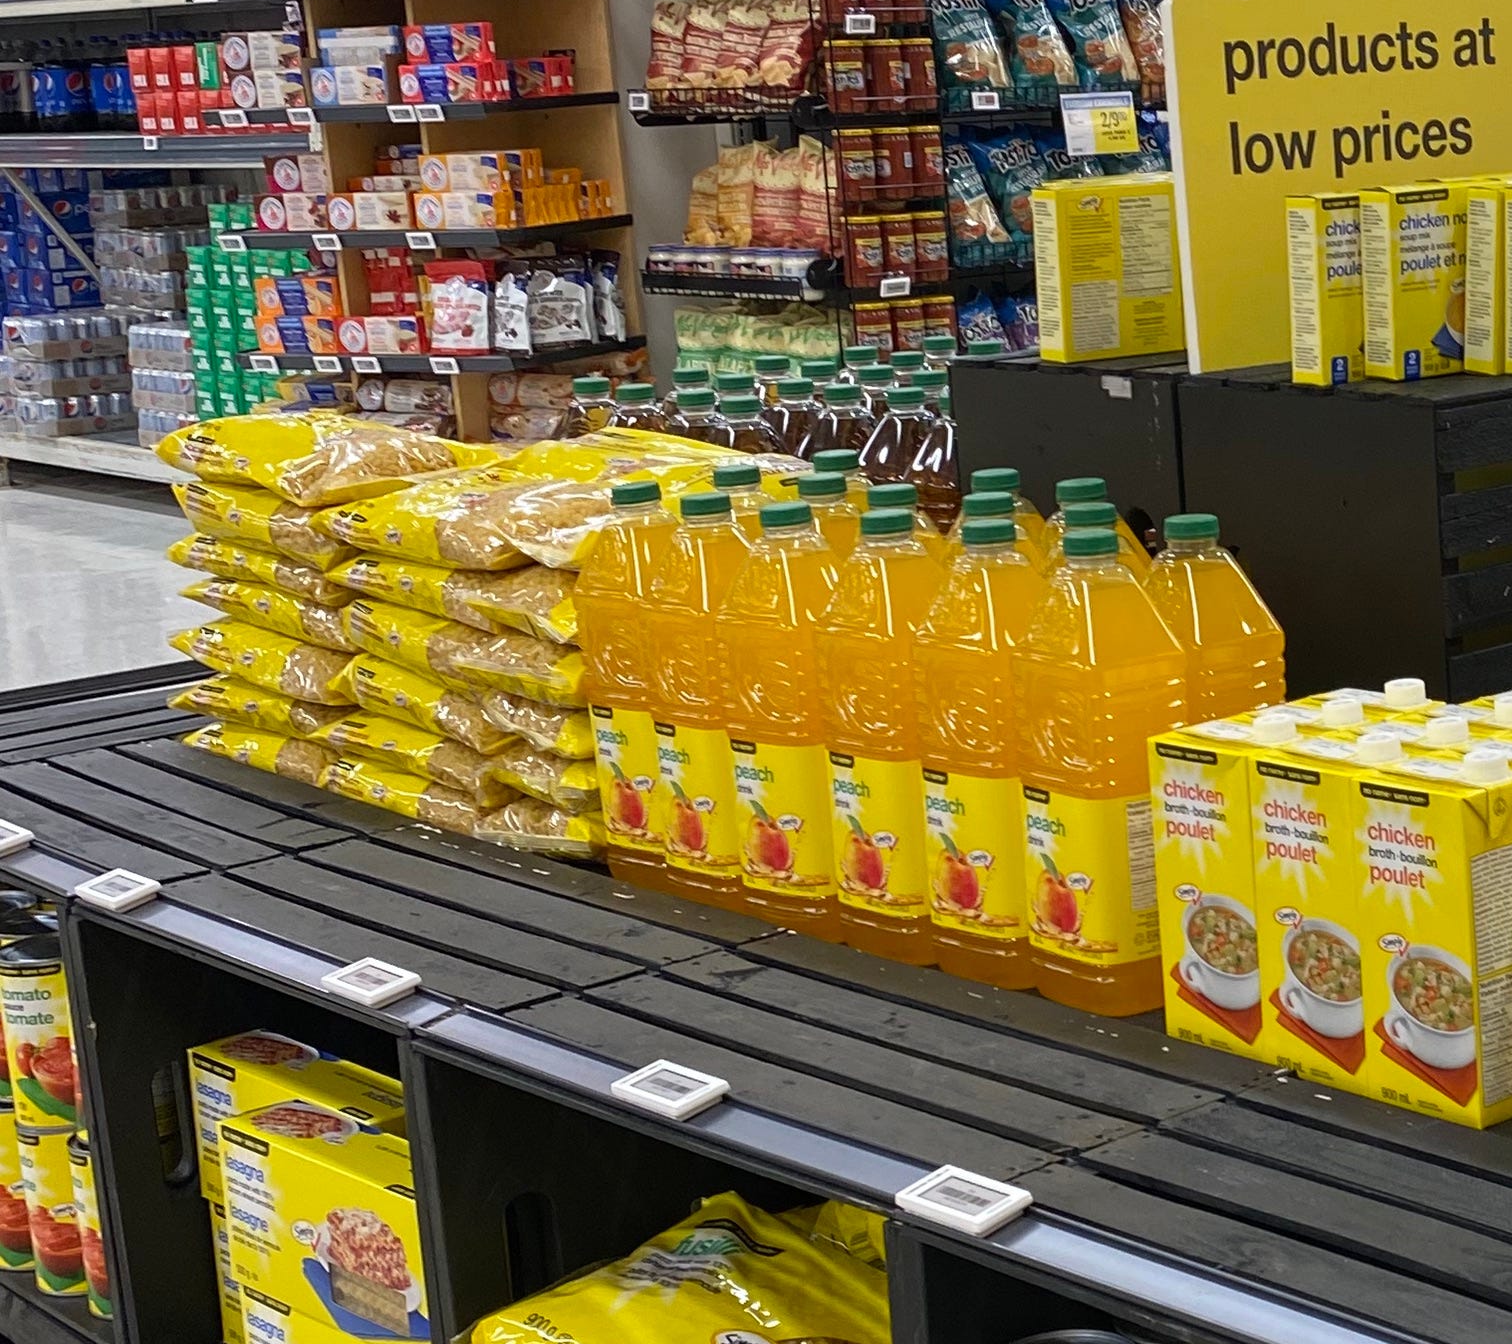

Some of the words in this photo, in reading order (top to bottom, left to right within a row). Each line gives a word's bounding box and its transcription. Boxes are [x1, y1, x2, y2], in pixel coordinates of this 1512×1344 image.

[1223, 21, 1439, 94] products
[1453, 17, 1496, 68] at
[1229, 120, 1317, 175] low
[1331, 110, 1473, 179] prices
[735, 762, 775, 784] peach
[925, 794, 967, 817] peach
[1163, 778, 1225, 807] chicken
[1026, 812, 1067, 838] peach
[1263, 798, 1328, 829] chicken
[1165, 819, 1216, 843] poulet
[1367, 822, 1436, 852] chicken
[1265, 840, 1318, 866] poulet
[1369, 863, 1425, 890] poulet
